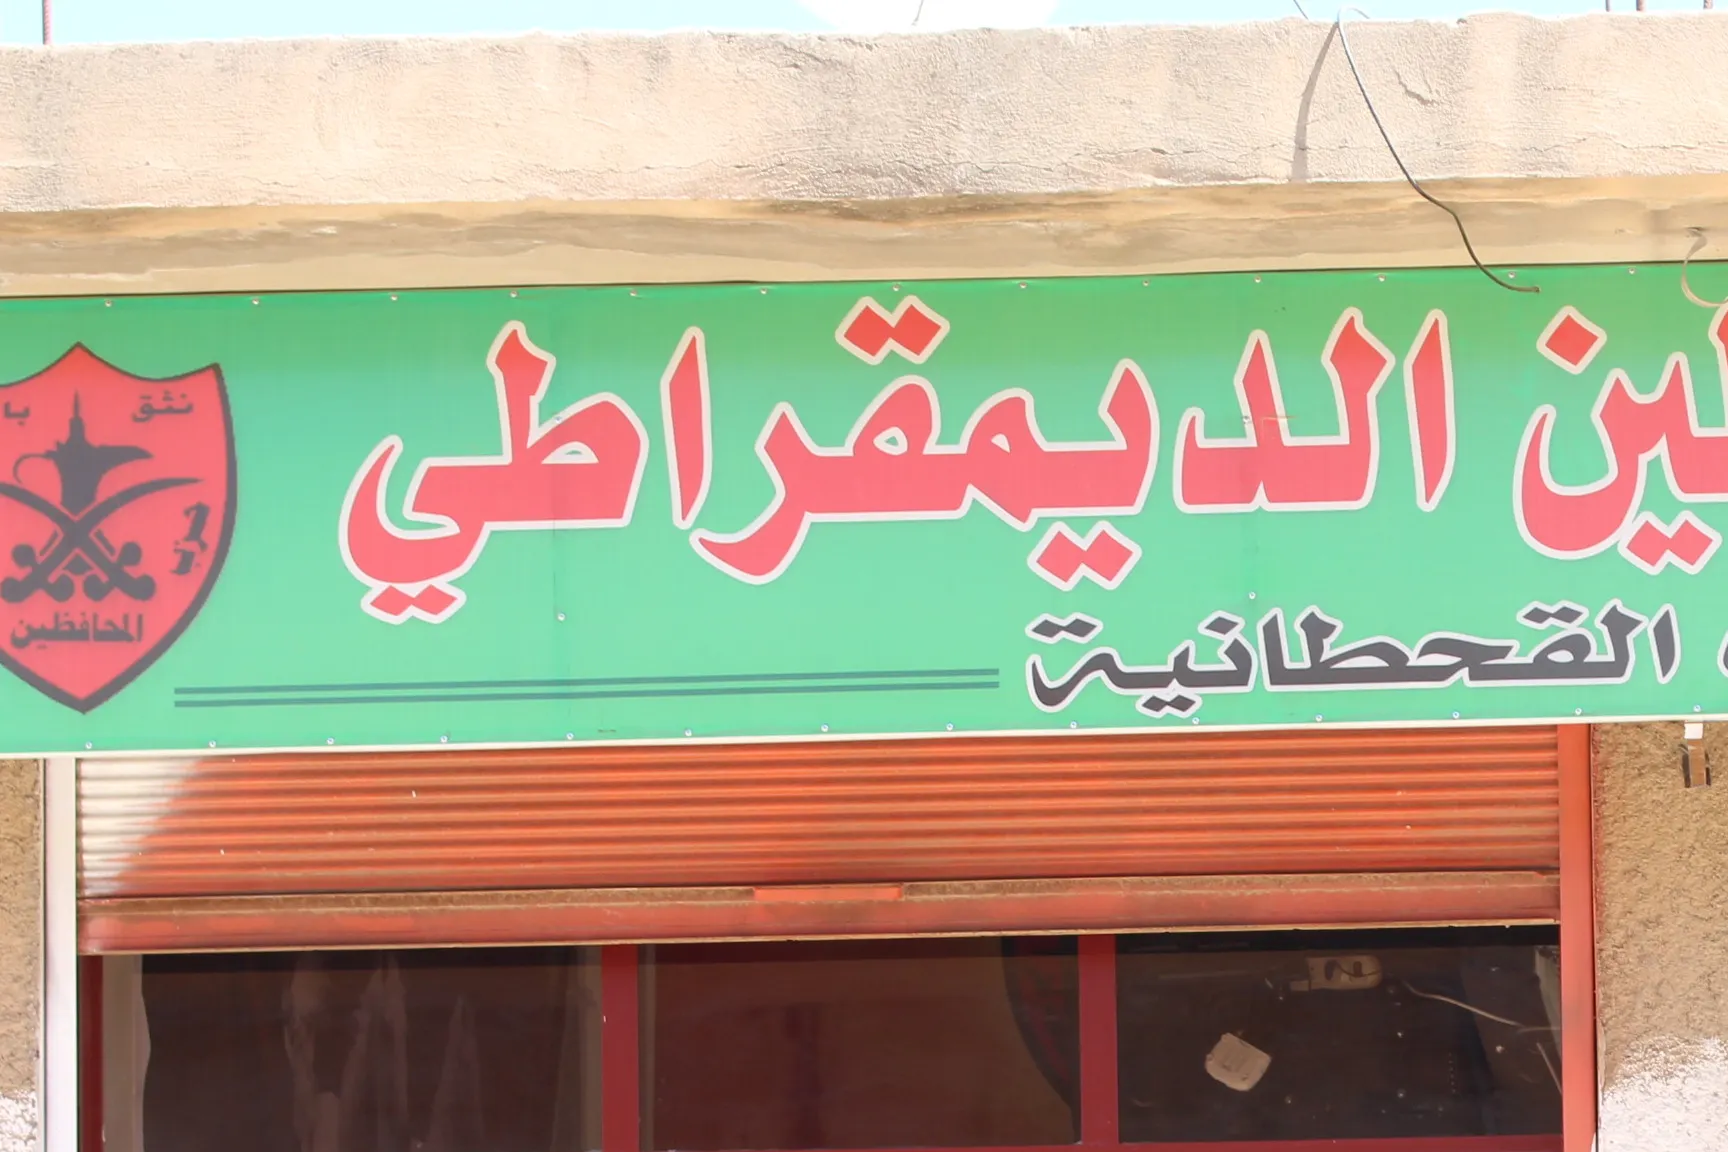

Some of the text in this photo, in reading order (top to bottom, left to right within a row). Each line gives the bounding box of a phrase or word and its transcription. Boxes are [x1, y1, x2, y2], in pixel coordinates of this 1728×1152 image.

[131, 389, 195, 423] نثق
[341, 299, 1454, 621] الديمقراطي
[169, 501, 211, 576] حزب
[9, 611, 144, 650] المحافظين
[1026, 601, 1680, 717] القحطانية
